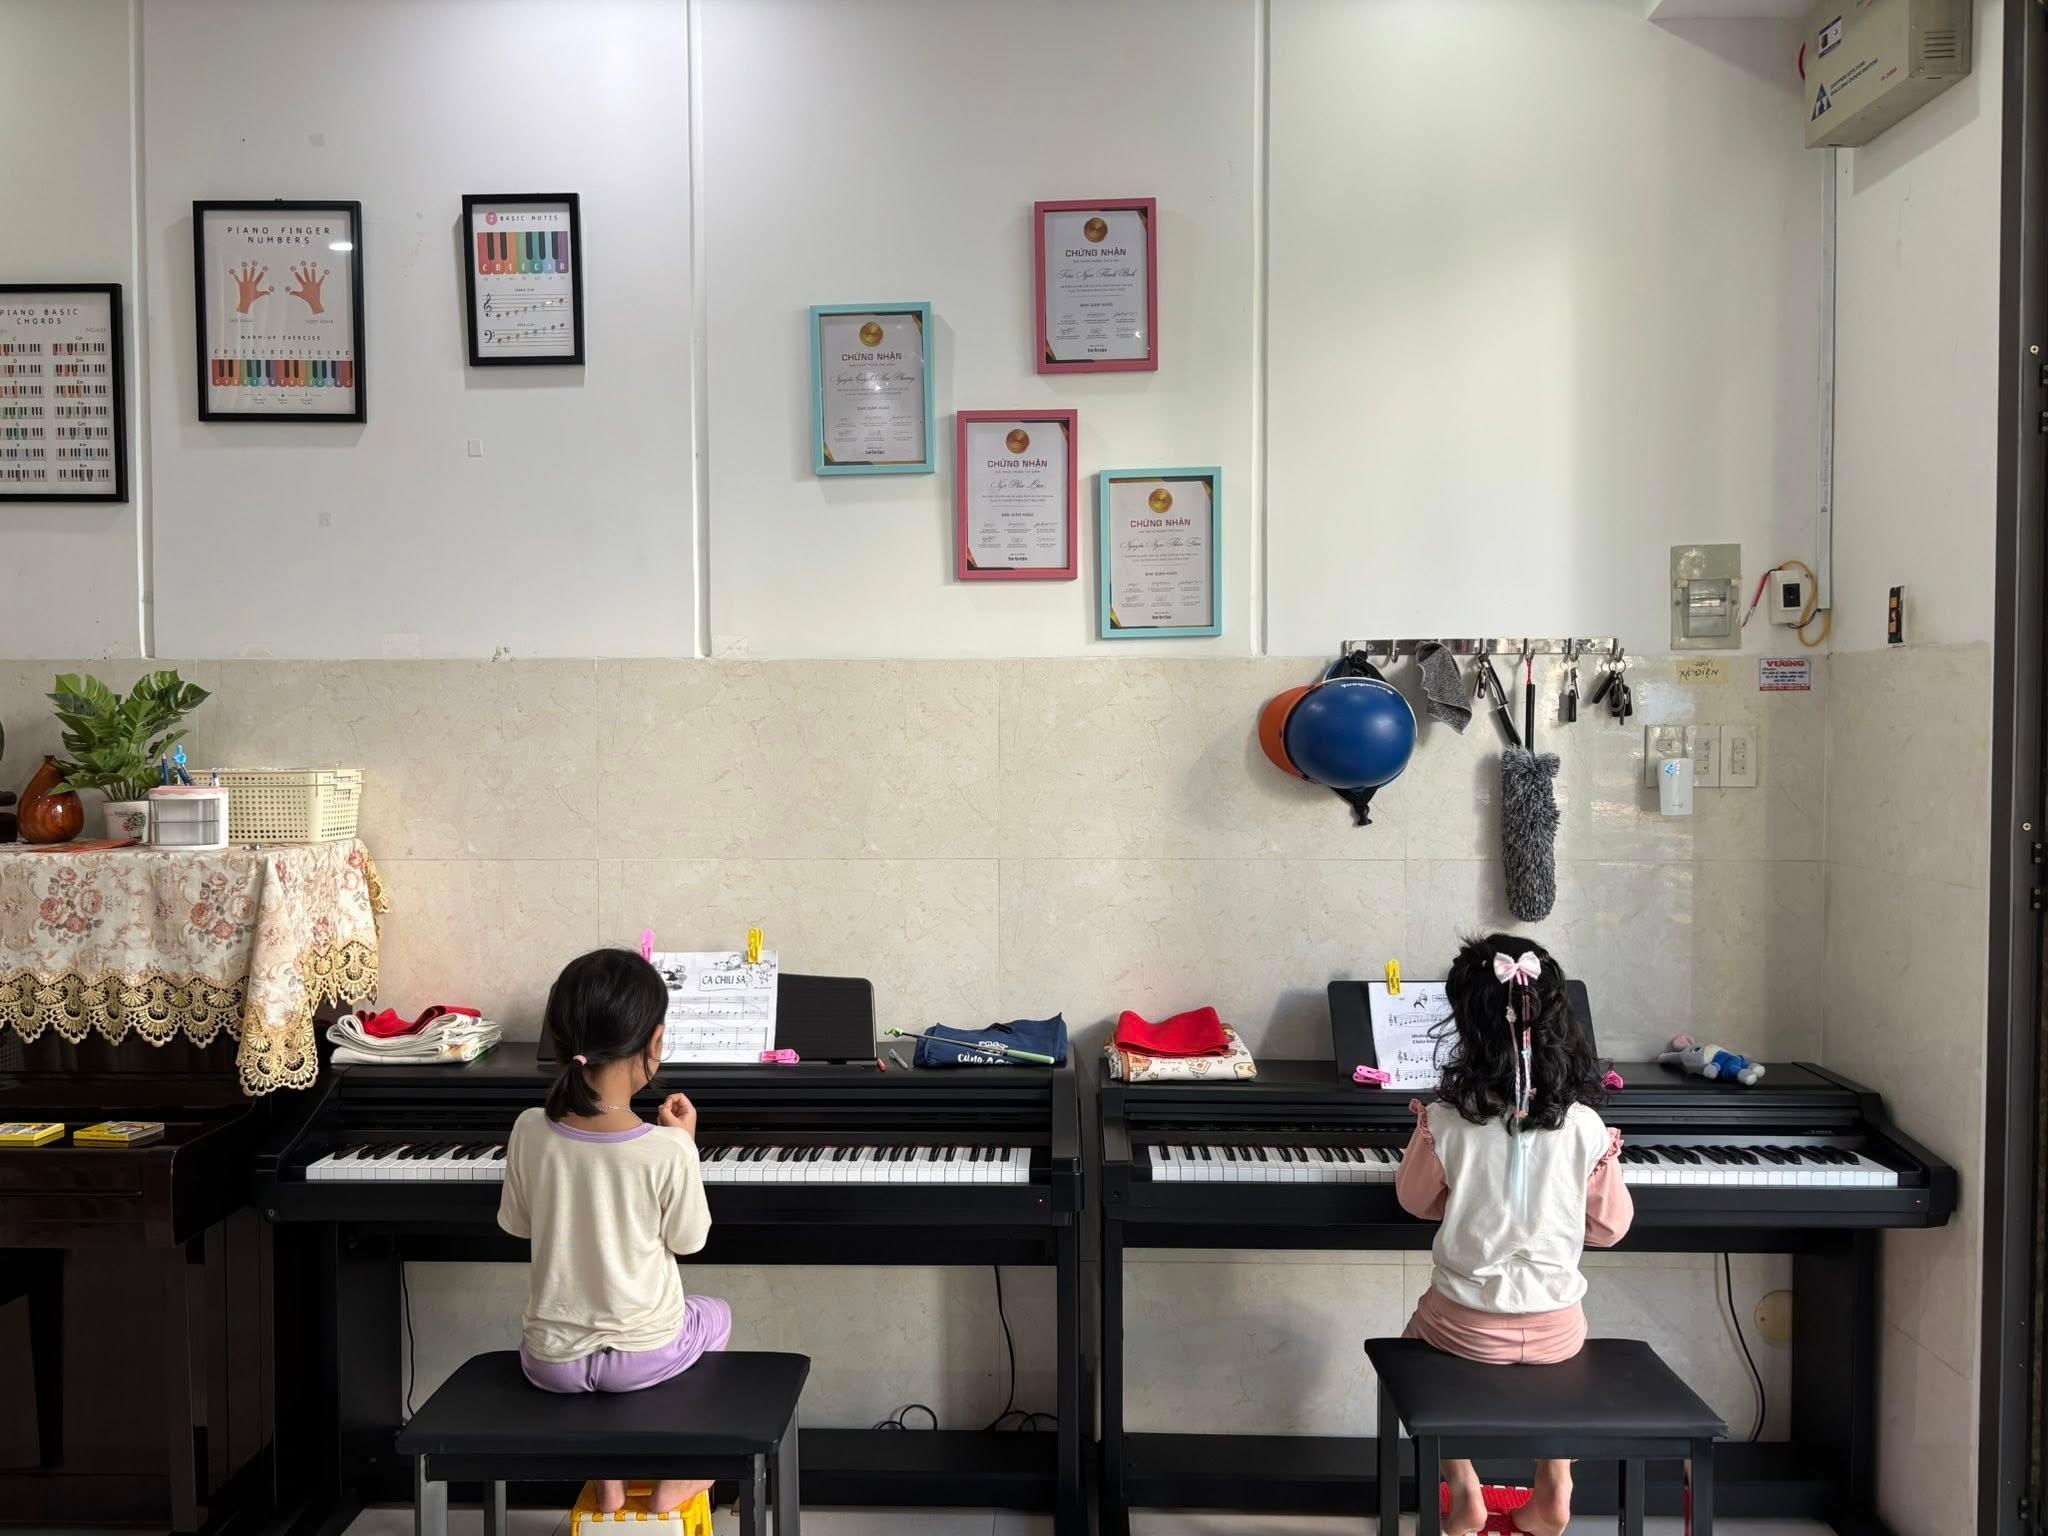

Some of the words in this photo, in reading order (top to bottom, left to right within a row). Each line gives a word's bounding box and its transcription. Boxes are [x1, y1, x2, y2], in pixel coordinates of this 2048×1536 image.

[226, 226, 269, 235] PIANO
[281, 226, 330, 235] FINGER
[247, 236, 311, 245] NUMBERS
[0, 308, 35, 316] PIANO
[44, 308, 78, 316] BASIC
[702, 975, 713, 985] CA
[735, 974, 746, 984] SA
